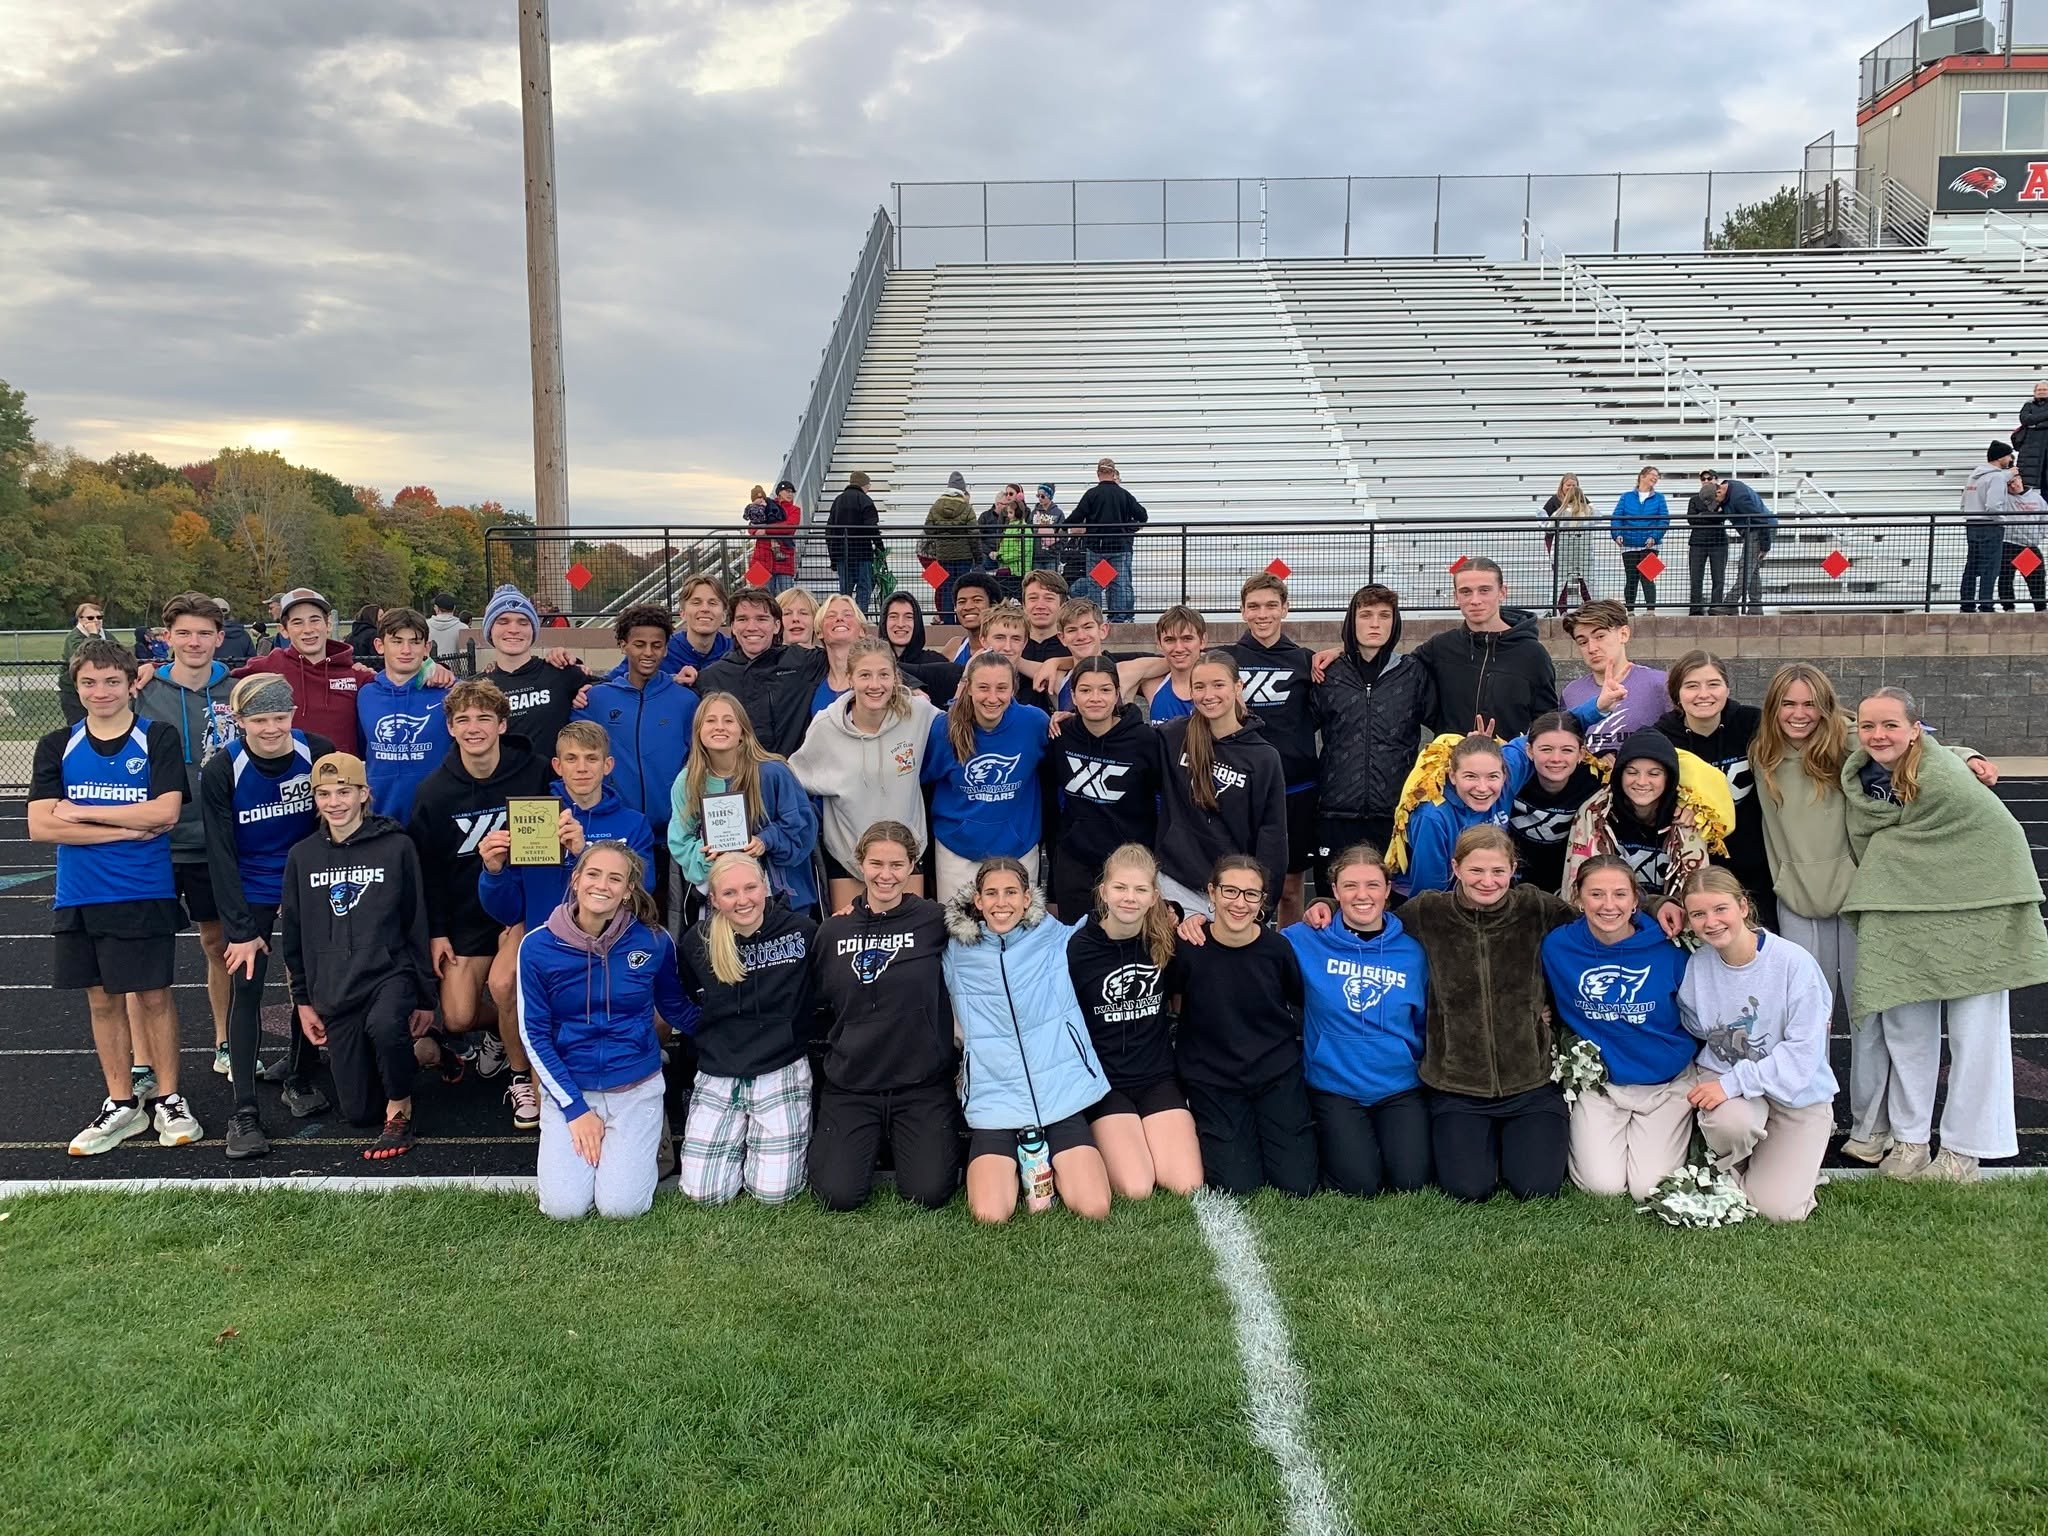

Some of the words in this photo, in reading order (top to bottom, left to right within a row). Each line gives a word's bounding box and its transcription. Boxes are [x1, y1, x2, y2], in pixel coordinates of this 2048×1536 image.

[1064, 755, 1131, 801] XC
[67, 785, 148, 802] COUGARS
[281, 781, 312, 803] 549
[238, 797, 313, 824] COUGARS
[309, 868, 385, 888] COUGARS
[837, 932, 915, 956] COUGARS
[1326, 958, 1407, 989] COUGARS
[1584, 1010, 1647, 1025] COUGARS
